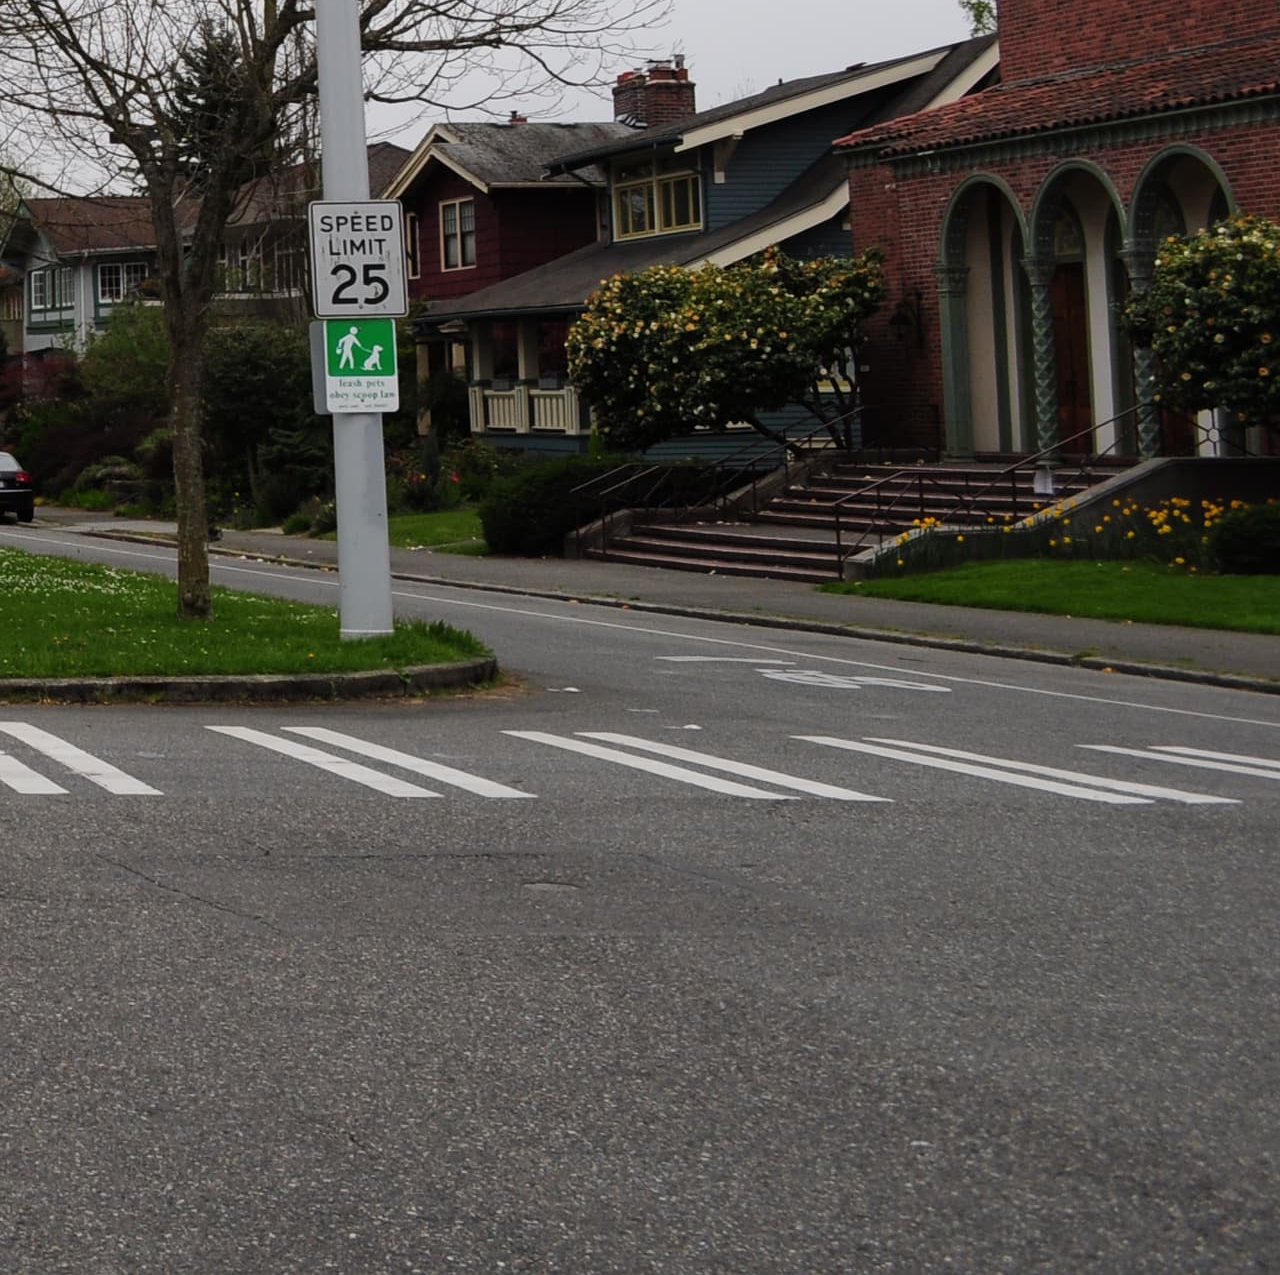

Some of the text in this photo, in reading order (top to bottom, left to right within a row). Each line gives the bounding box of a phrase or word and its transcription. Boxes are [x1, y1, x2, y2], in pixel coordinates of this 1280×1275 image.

[319, 214, 394, 233] SPEED
[328, 238, 387, 257] LIMIT
[330, 263, 390, 305] 25
[338, 378, 385, 389] leash pets
[329, 390, 395, 400] obey scoop law
